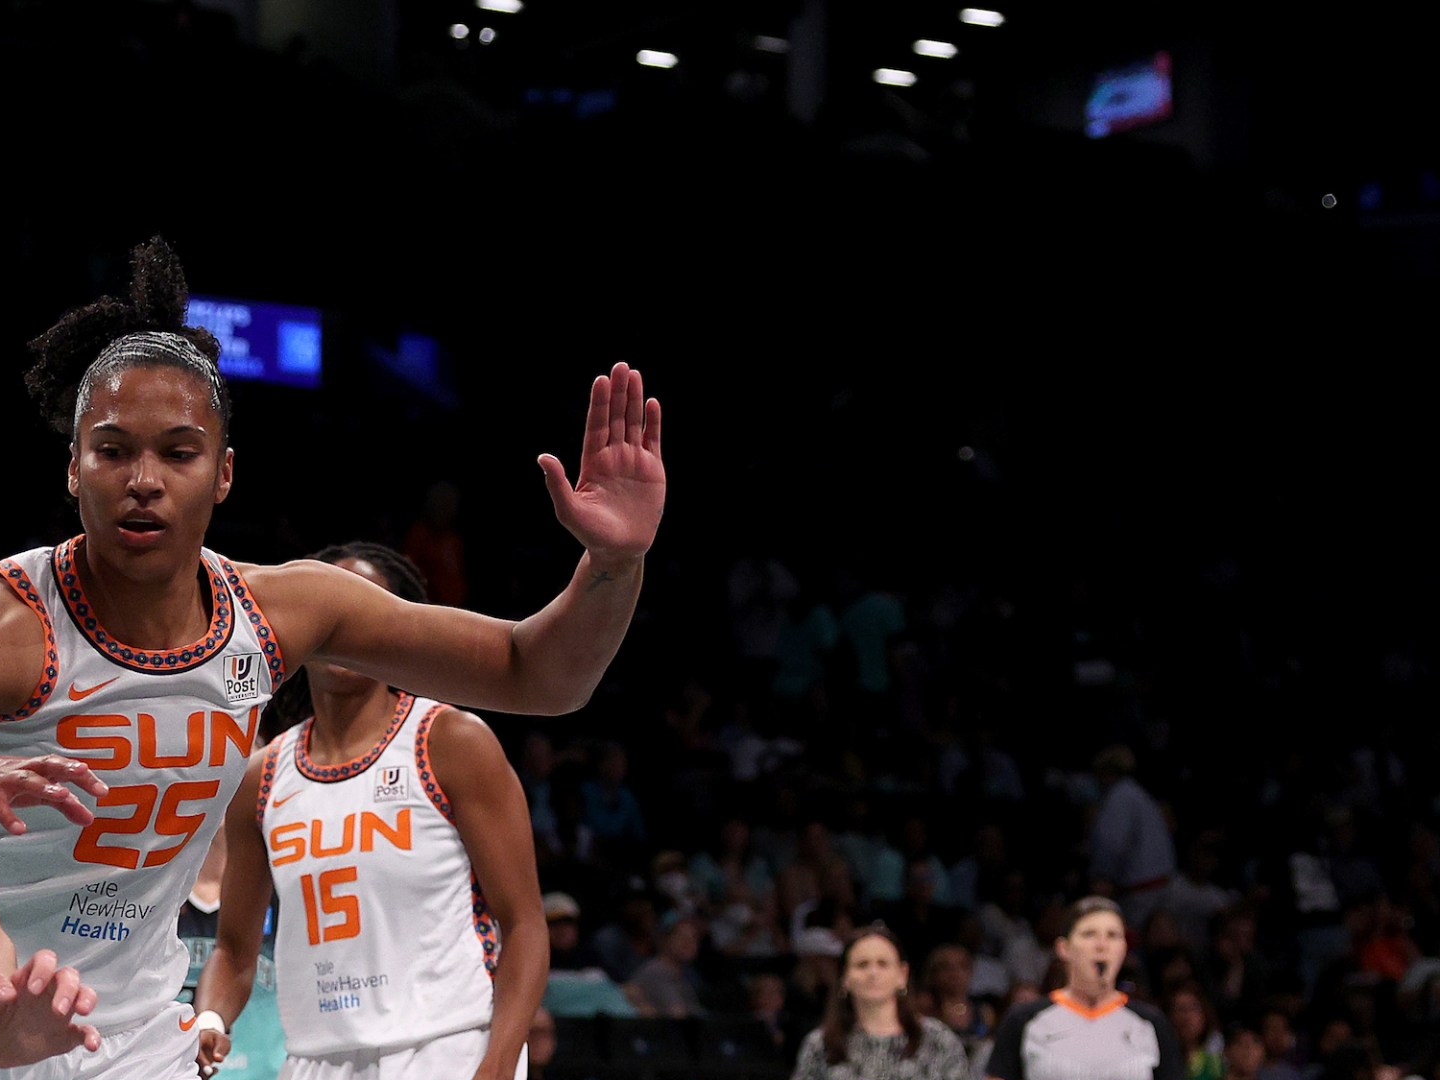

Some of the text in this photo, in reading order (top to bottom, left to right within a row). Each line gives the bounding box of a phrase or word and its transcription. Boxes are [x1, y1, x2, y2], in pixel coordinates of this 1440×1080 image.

[226, 678, 256, 694] Post
[57, 704, 259, 770] SUN
[376, 785, 405, 797] Post
[73, 779, 221, 869] 25
[270, 808, 412, 867] SUN
[81, 881, 118, 897] ale
[69, 893, 156, 919] NewHav
[300, 866, 361, 946] 15
[61, 915, 130, 941] Health
[317, 974, 389, 994] NewHaven
[319, 994, 360, 1013] Health
